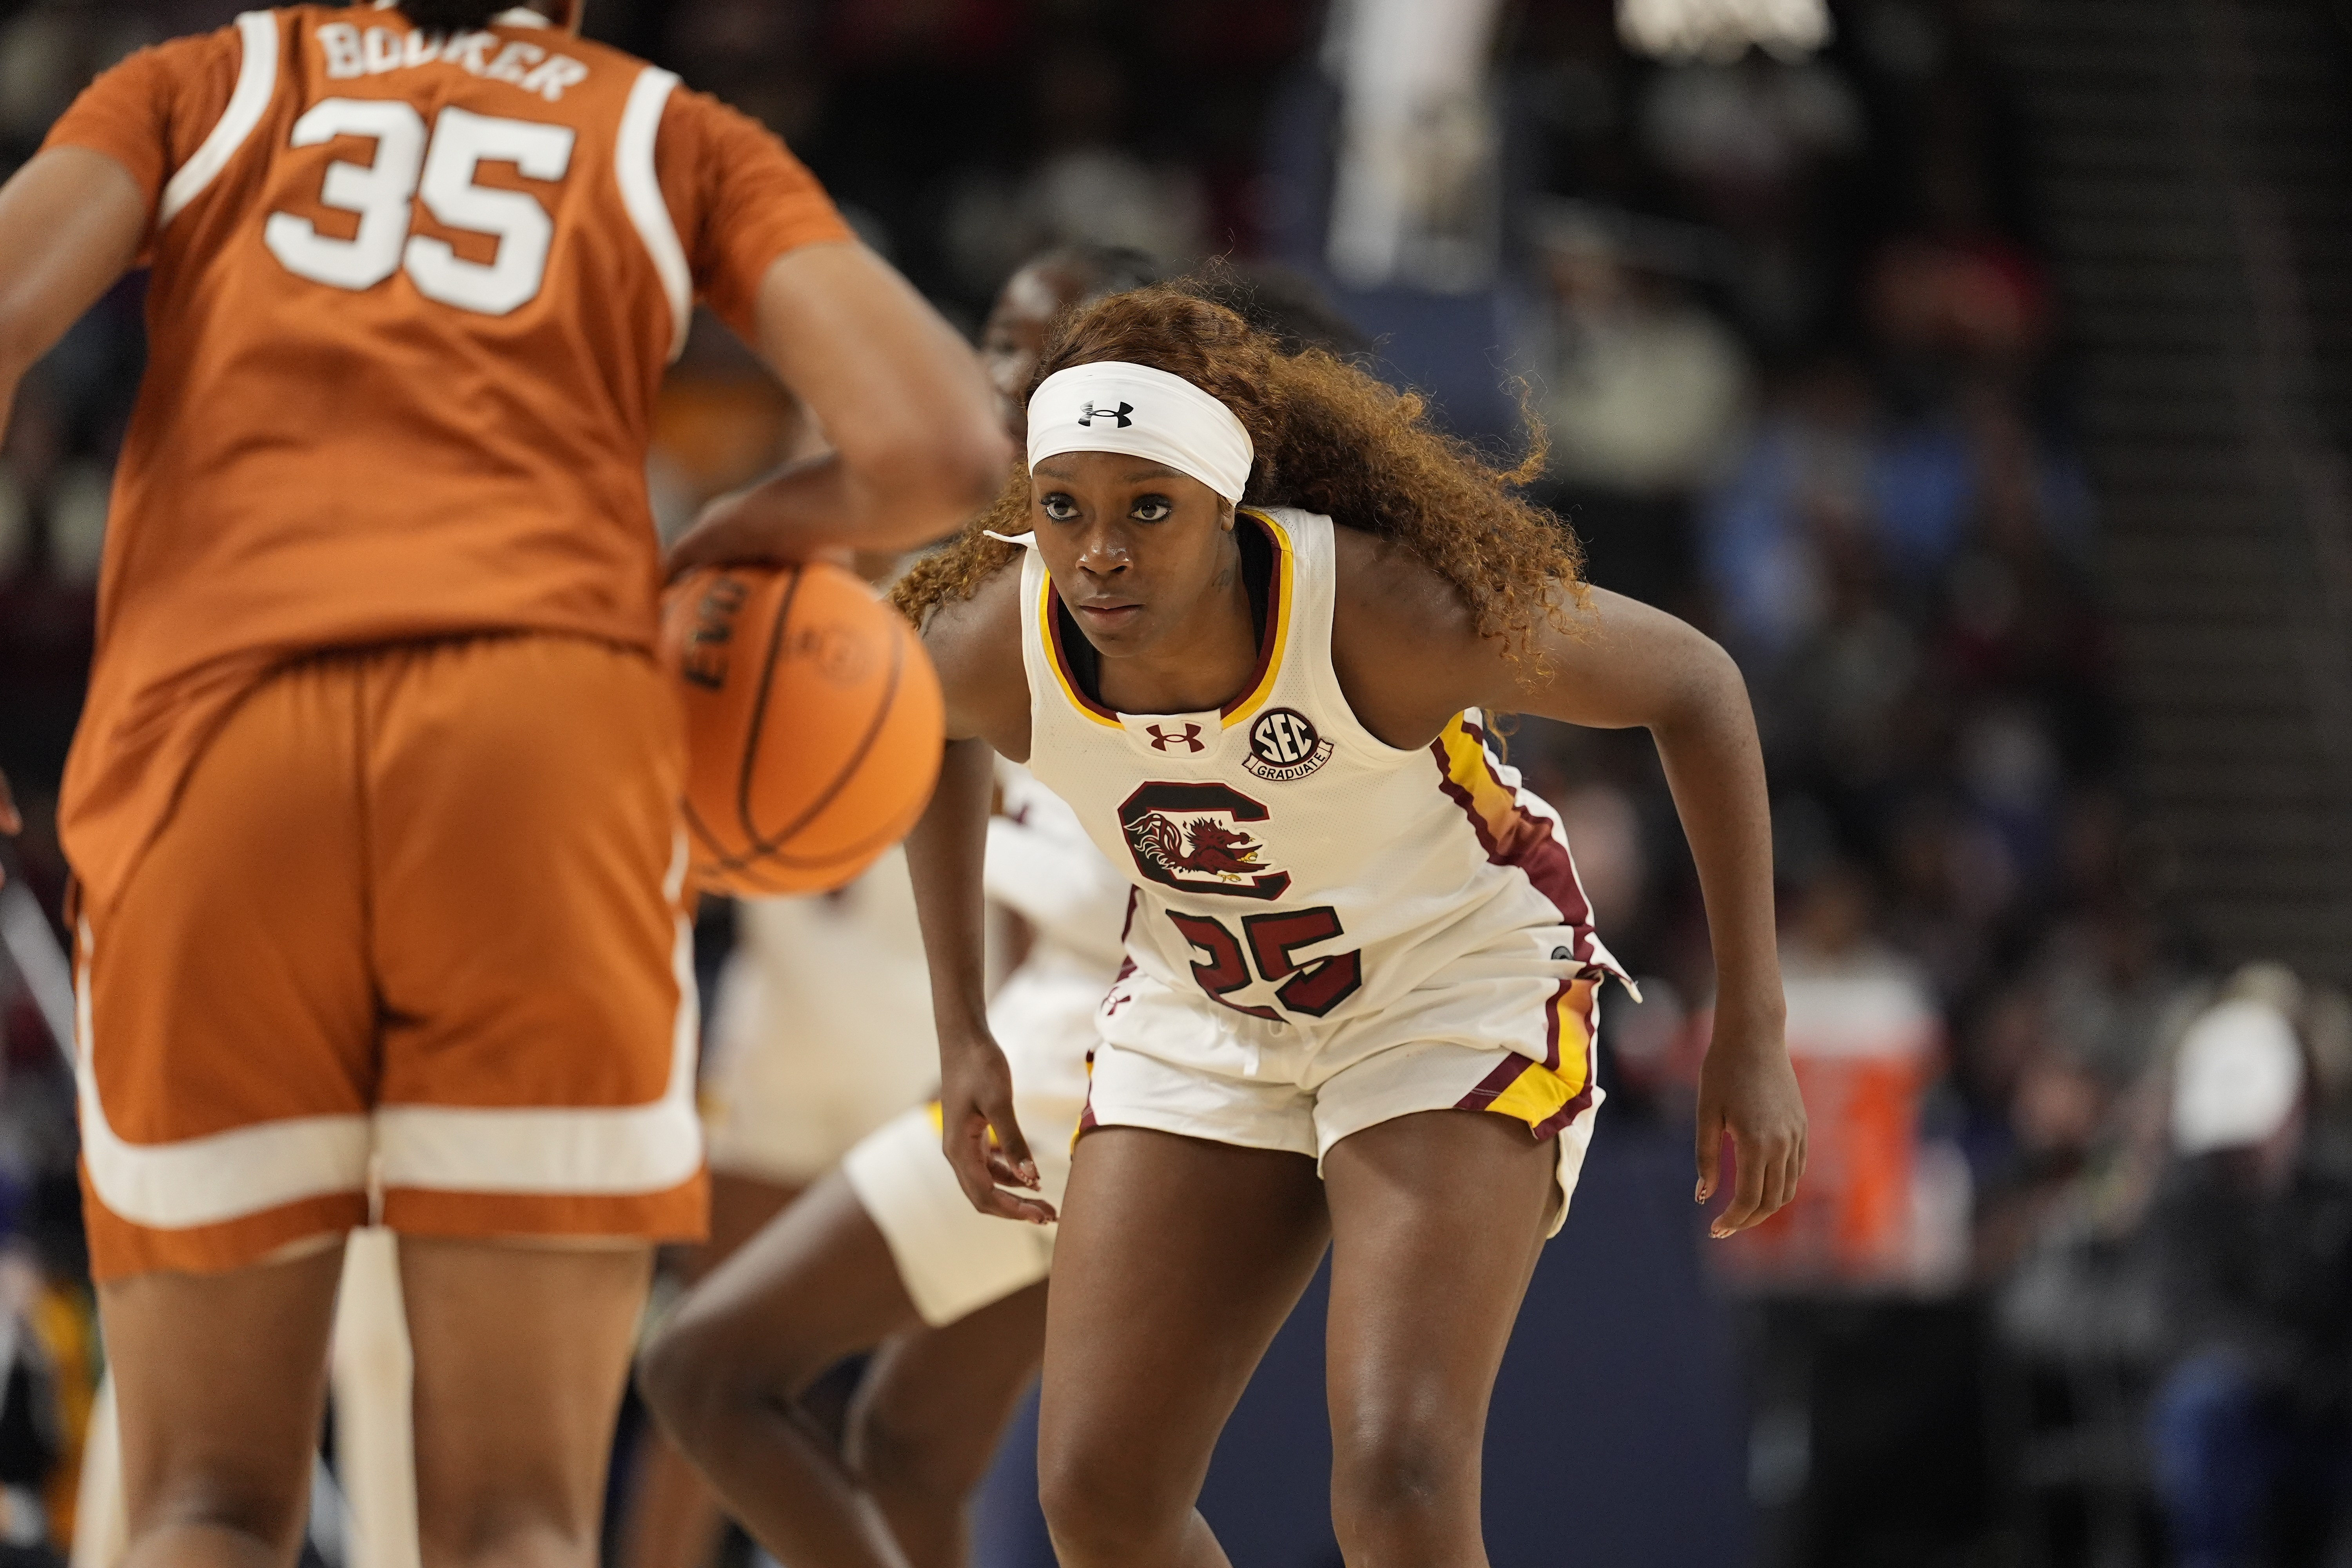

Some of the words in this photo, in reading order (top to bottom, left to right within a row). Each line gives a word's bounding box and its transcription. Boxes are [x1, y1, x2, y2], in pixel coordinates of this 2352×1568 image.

[263, 97, 576, 316] 35
[1255, 713, 1312, 763] SEC
[1257, 752, 1325, 779] GRADUATE
[1117, 781, 1291, 900] C
